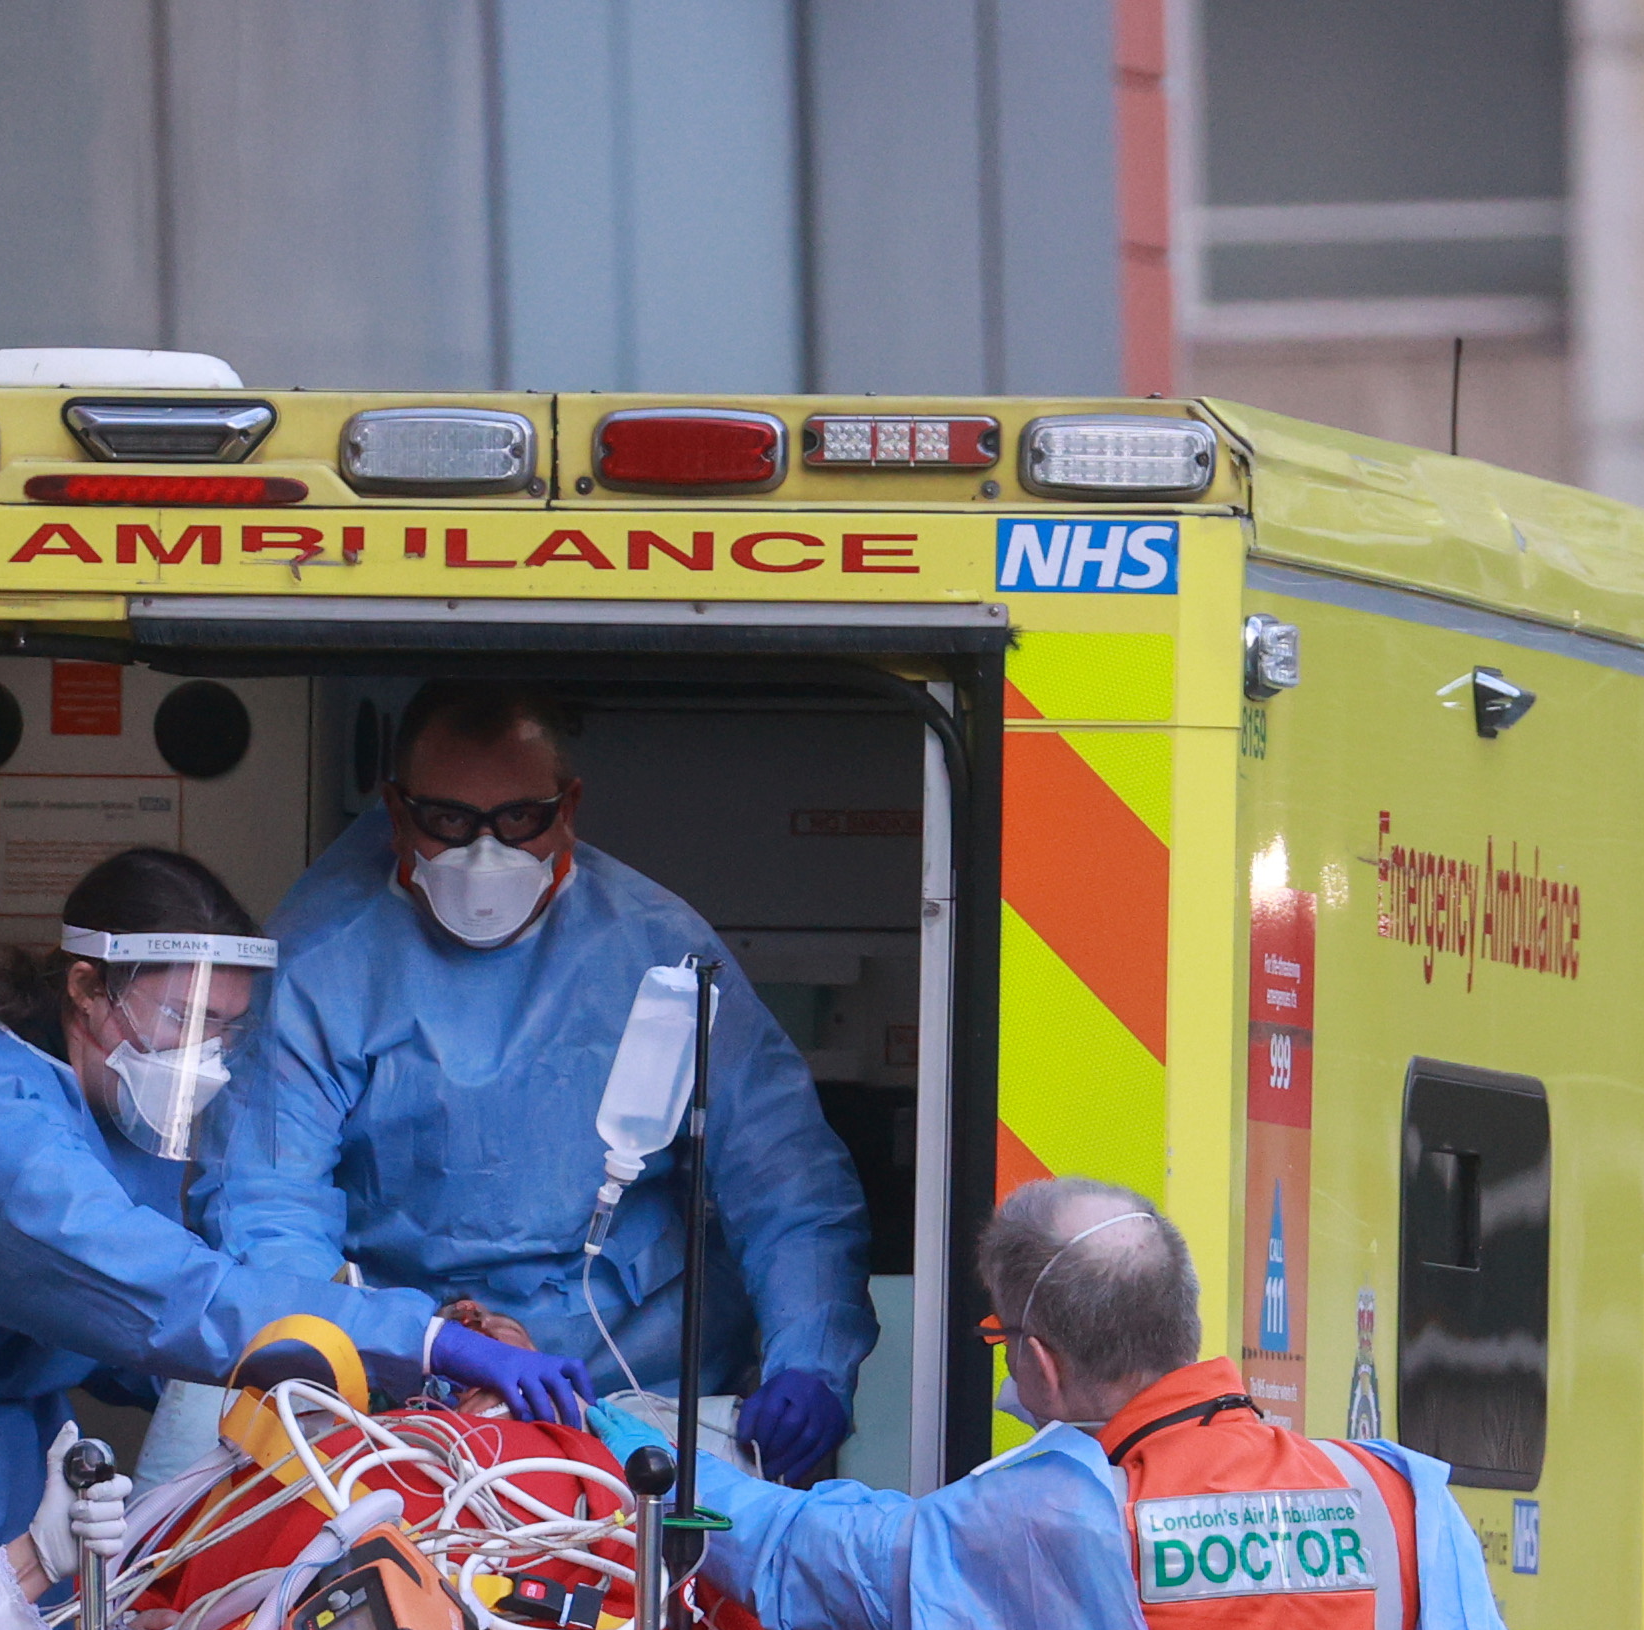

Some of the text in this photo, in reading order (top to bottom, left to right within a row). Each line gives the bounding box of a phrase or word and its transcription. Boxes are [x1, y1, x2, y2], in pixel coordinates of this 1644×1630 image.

[999, 522, 1175, 590] NHS
[1241, 705, 1268, 761] 8159
[1377, 810, 1580, 994] Emergency Ambulance
[1269, 1033, 1292, 1090] 999
[1268, 1238, 1284, 1263] CALL
[1265, 1276, 1285, 1334] 111
[1150, 1509, 1239, 1533] London's
[1244, 1506, 1264, 1526] Air
[1153, 1527, 1368, 1588] DOCTOR
